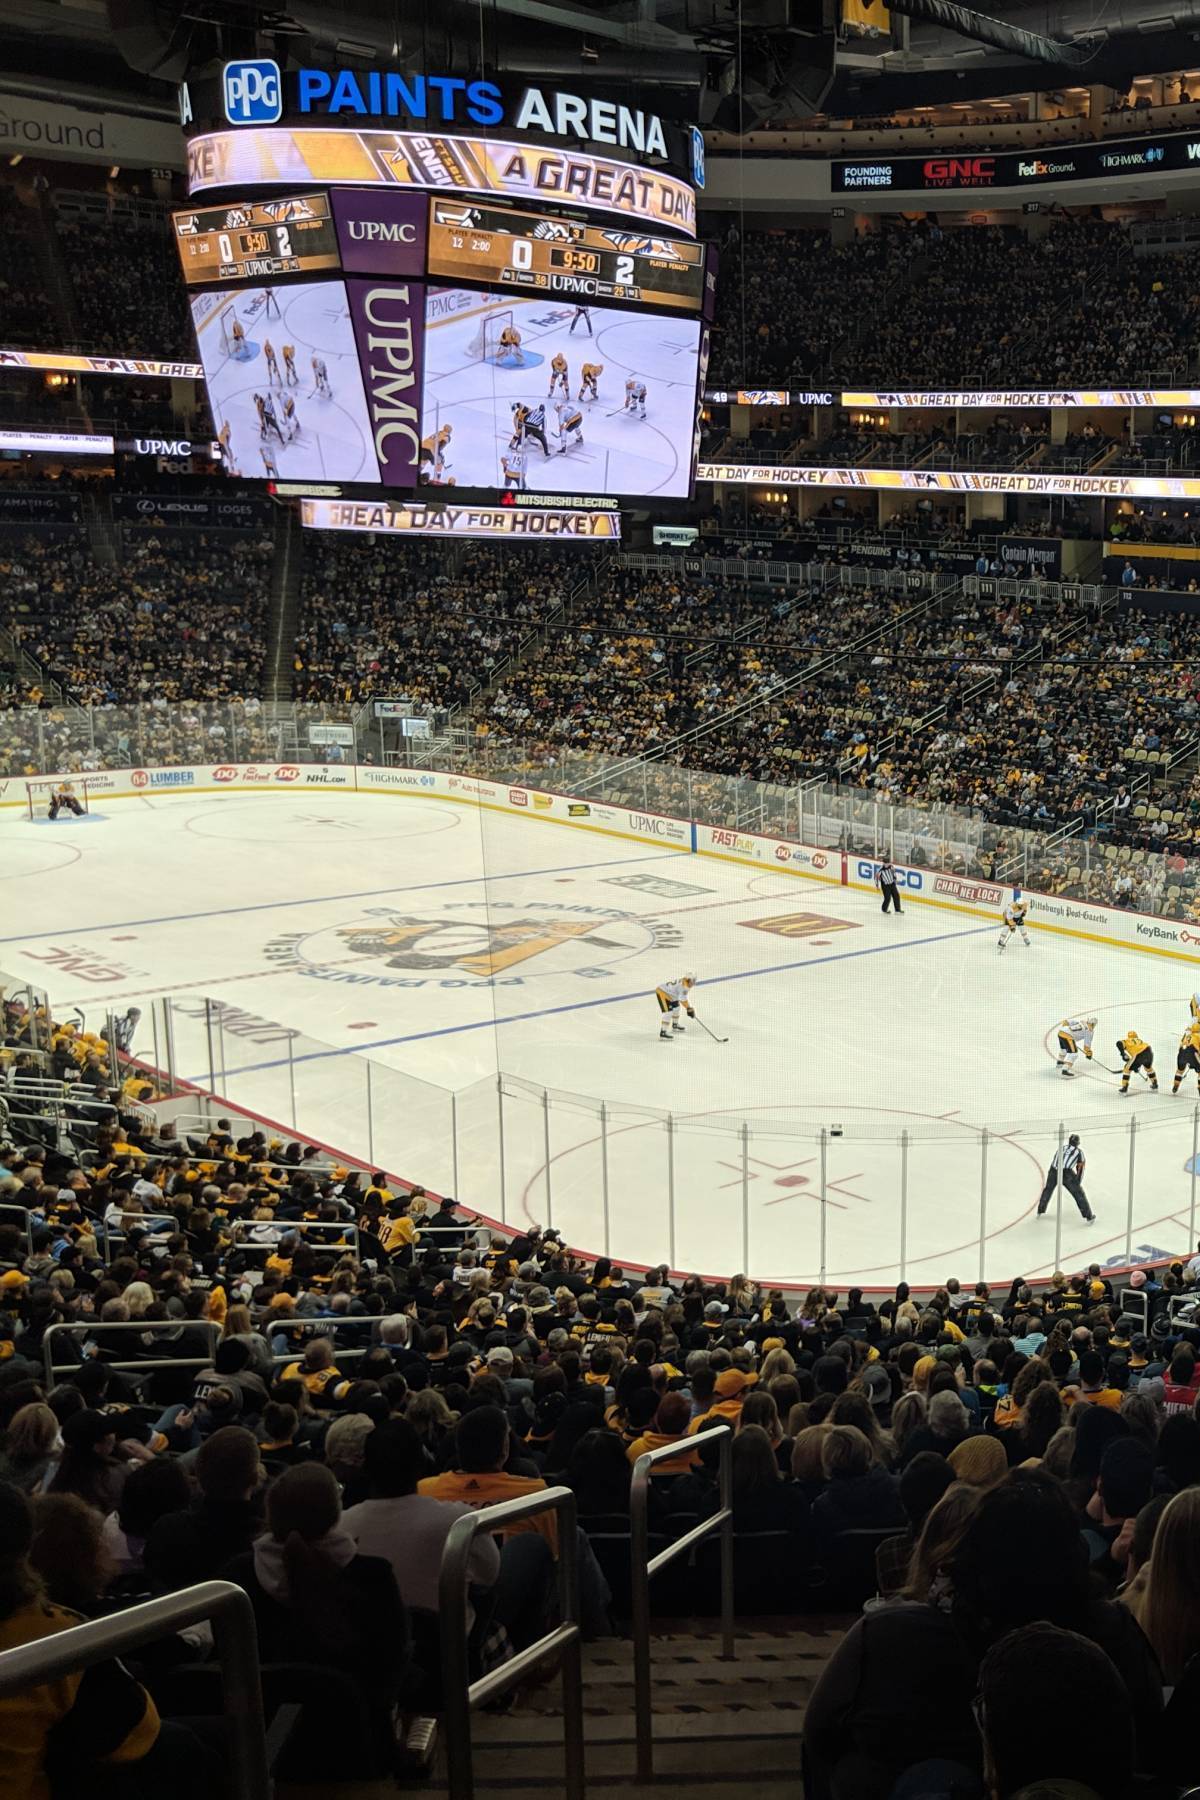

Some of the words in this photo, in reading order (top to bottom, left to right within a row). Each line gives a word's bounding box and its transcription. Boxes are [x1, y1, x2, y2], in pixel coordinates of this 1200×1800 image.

[228, 68, 277, 116] PPG
[299, 69, 504, 125] PAINTS
[516, 88, 668, 159] ARENA
[923, 159, 995, 178] GNC
[1018, 160, 1048, 177] FedEx
[1101, 152, 1147, 168] HIGHMARK
[844, 167, 892, 177] FOUNDING
[844, 175, 892, 186] PARTNERS
[503, 155, 527, 180] A
[535, 159, 656, 209] GREAT
[659, 184, 691, 224] DAY
[959, 177, 994, 186] WELL
[347, 222, 416, 243] UPMC
[572, 228, 580, 239] 3
[218, 233, 234, 263] 0
[247, 233, 268, 252] 9:50
[276, 226, 293, 257] 2
[452, 236, 463, 249] 12
[471, 240, 491, 252] 2:00
[512, 240, 533, 270] 0
[563, 252, 596, 271] 9:50
[246, 260, 273, 275] UPMC
[615, 256, 634, 285] 2
[552, 274, 596, 296] UPMC
[613, 286, 626, 297] 25
[364, 286, 419, 466] UPMC
[799, 393, 832, 405] UPMC
[920, 394, 960, 406] GREAT
[961, 393, 983, 406] DAY
[1003, 393, 1054, 406] HOCKEY
[135, 439, 191, 456] UPMC
[726, 467, 751, 481] DAY
[752, 470, 770, 480] FOR
[772, 469, 827, 483] HOCKEY
[982, 476, 1023, 490] GREAT
[1026, 477, 1051, 491] DAY
[1053, 479, 1071, 489] FOR
[1072, 478, 1129, 494] HOCKEY
[218, 504, 253, 515] LOGES
[516, 494, 572, 507] MITSUBISHI
[573, 496, 618, 509] ELECTRIC
[411, 509, 462, 530] DAY
[467, 513, 505, 528] FOR
[511, 511, 600, 535] HOCKEY
[850, 545, 892, 558] PENGUINS
[1001, 544, 1028, 562] Captain
[685, 560, 699, 571] 110
[907, 575, 922, 588] 110
[981, 582, 994, 594] 111
[1063, 588, 1077, 600] 111
[133, 773, 147, 785] 84
[151, 771, 194, 784] LUMBER
[367, 773, 419, 785] HIGHMARK
[629, 814, 666, 837] UPMC
[813, 855, 827, 867] DQ
[1029, 899, 1065, 917] Pittsburgh
[1065, 907, 1108, 925] Post-Gazette
[639, 918, 685, 950] ARENA
[1137, 923, 1178, 942] KeyBank
[263, 933, 309, 967] ARENA
[19, 946, 127, 983] GNC
